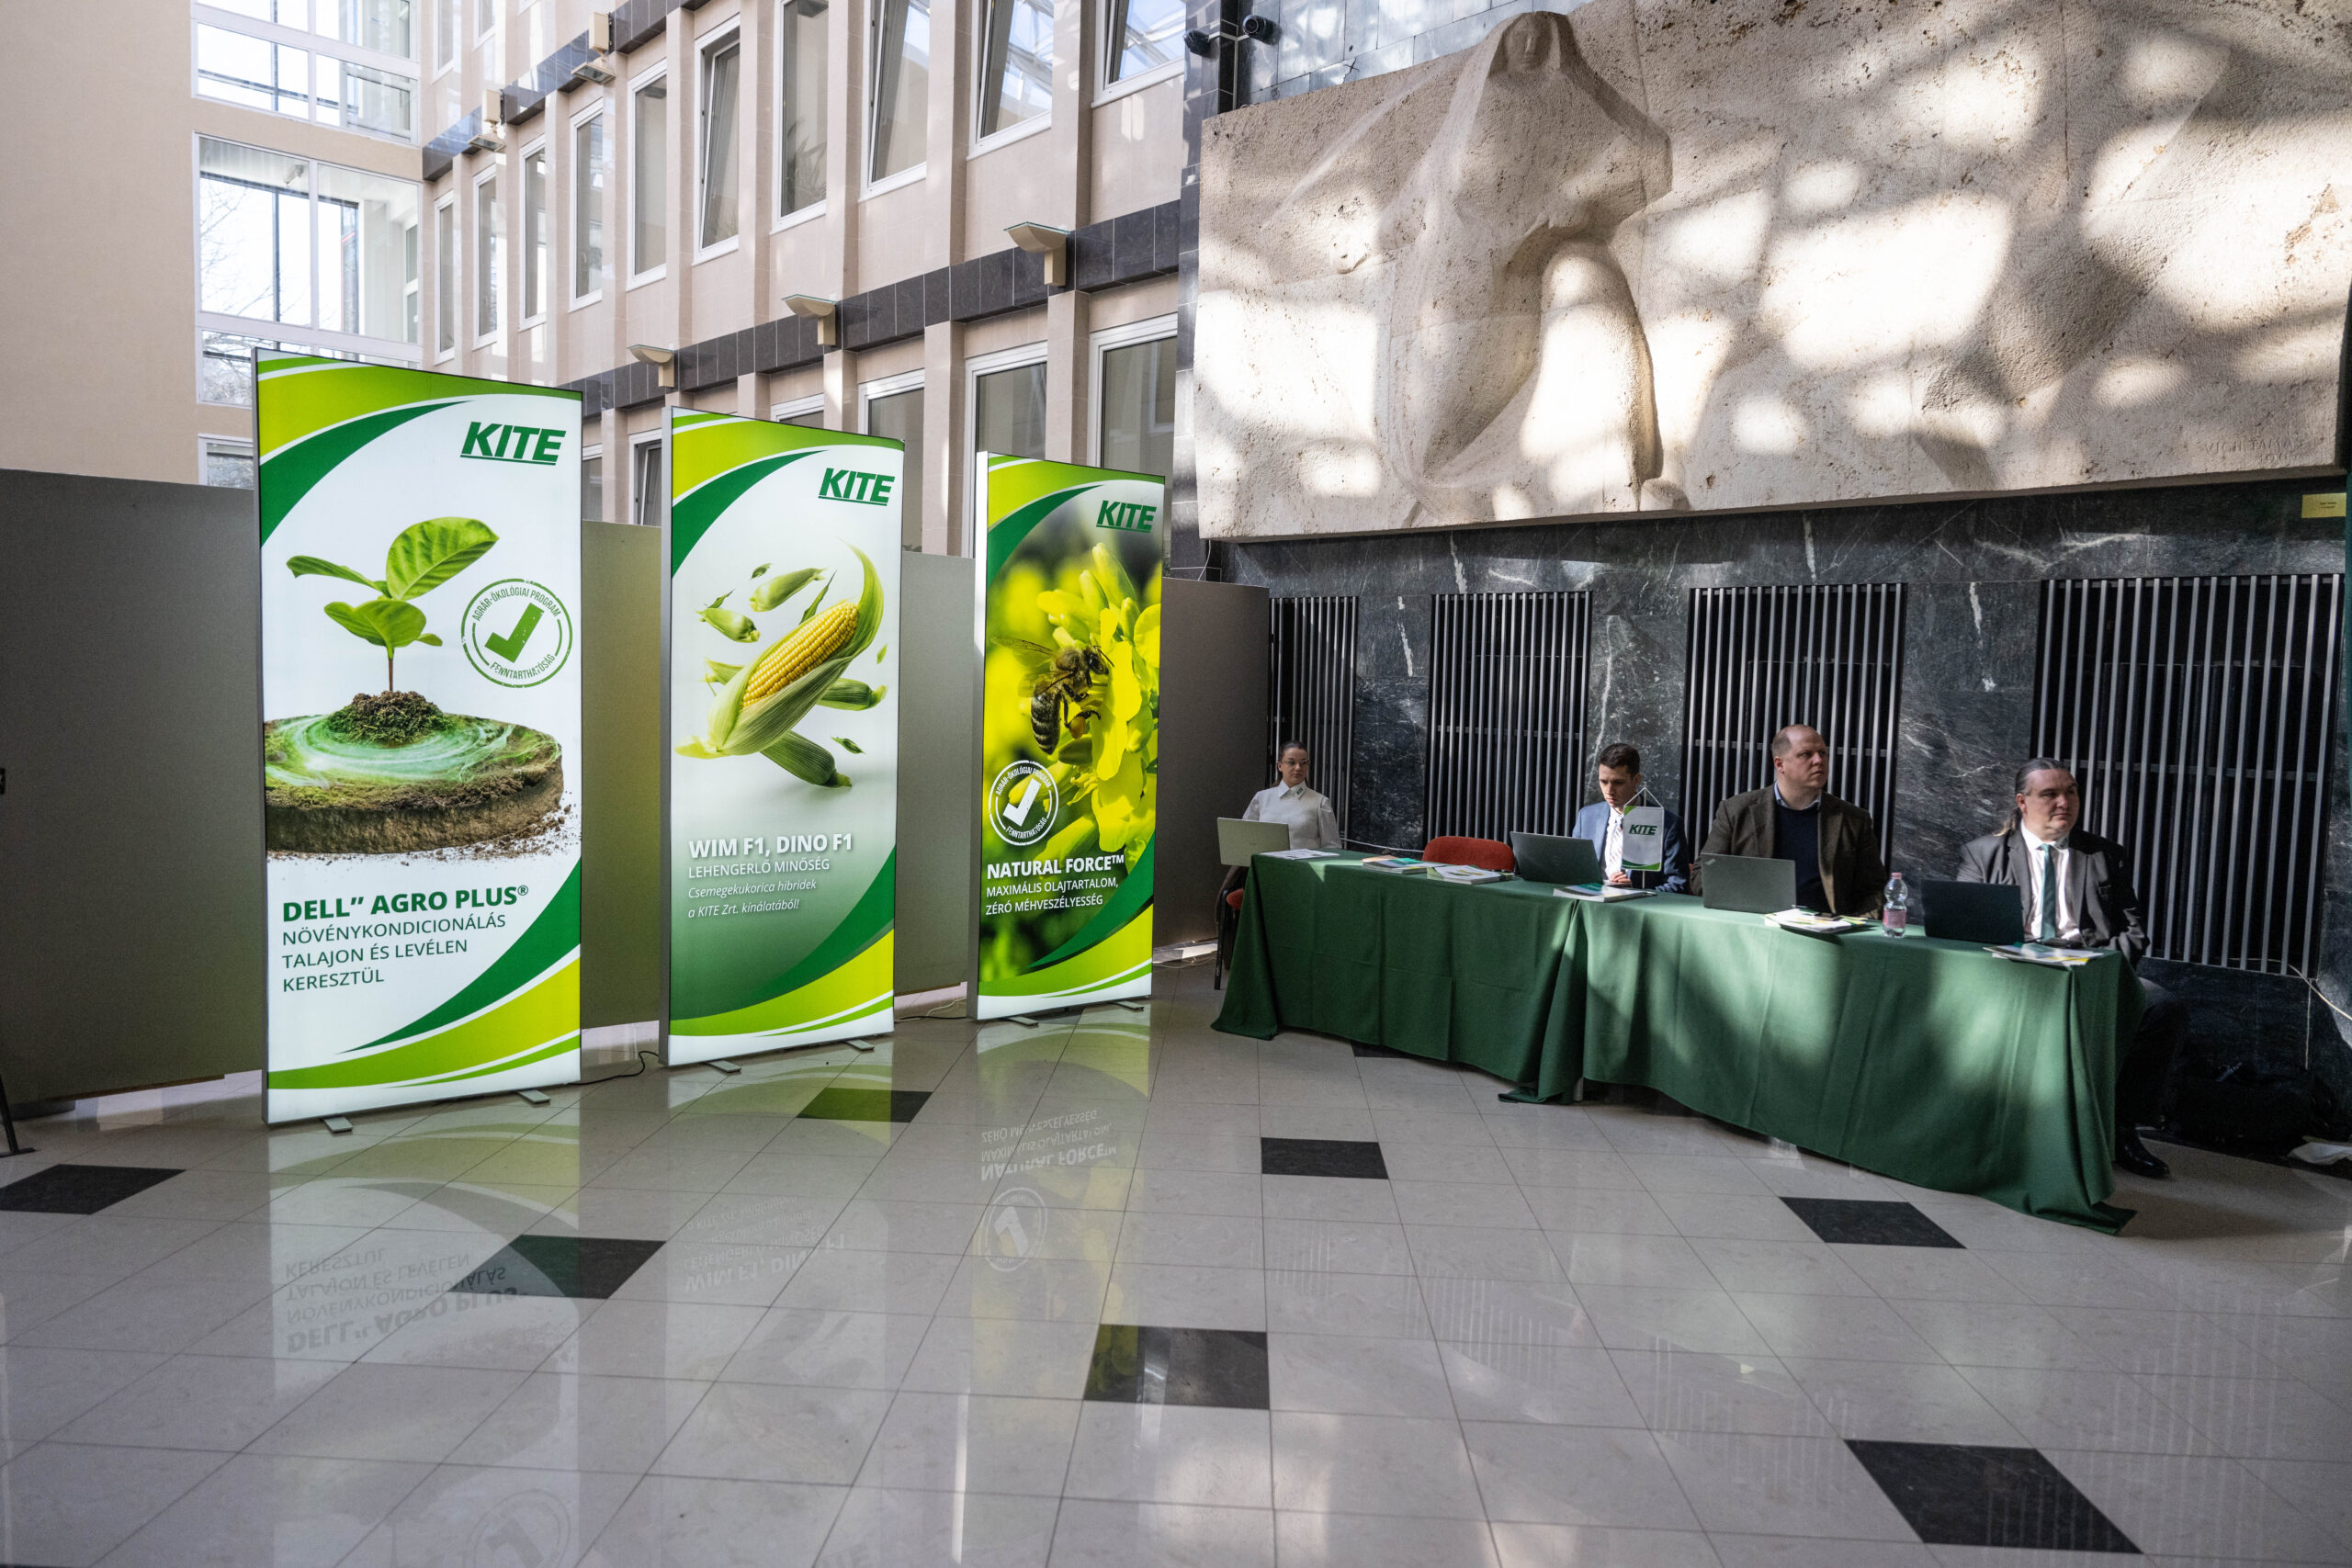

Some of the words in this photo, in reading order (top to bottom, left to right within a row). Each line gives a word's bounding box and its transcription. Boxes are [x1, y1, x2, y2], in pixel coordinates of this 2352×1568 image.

[460, 422, 567, 465] KITE
[819, 468, 896, 505] KITE
[1096, 501, 1157, 532] KITE
[530, 590, 561, 617] PROGRAM
[490, 653, 556, 680] FENNTARTHATÓSÁG
[1628, 824, 1657, 836] KITE
[689, 839, 738, 859] WIM
[743, 837, 771, 858] F1,
[776, 834, 828, 853] DINO
[832, 833, 853, 851] F1
[689, 860, 771, 878] LEHENGERLŐ
[775, 856, 831, 873] MINŐSÉG
[987, 859, 1062, 880] NATURAL
[689, 882, 775, 898] Csemegekukorica
[777, 878, 817, 892] hibridek
[986, 880, 1042, 897] MAXIMÁLIS
[1045, 877, 1119, 894] OLAJTARTALOM,
[370, 890, 447, 915] AGRO
[688, 908, 695, 919] a
[697, 905, 719, 918] KITE
[721, 903, 739, 916] Zrt.
[986, 899, 1012, 916] ZÉRÓ
[1014, 894, 1103, 913] MÉHVESZÉLYESSÉG
[282, 913, 506, 946] NÖVÉNYKONDICIONÁLÁS
[282, 947, 364, 969] TALAJON
[370, 942, 390, 961] ÉS
[395, 938, 468, 958] LEVÉLEN
[283, 966, 384, 992] KERESZTÜL
